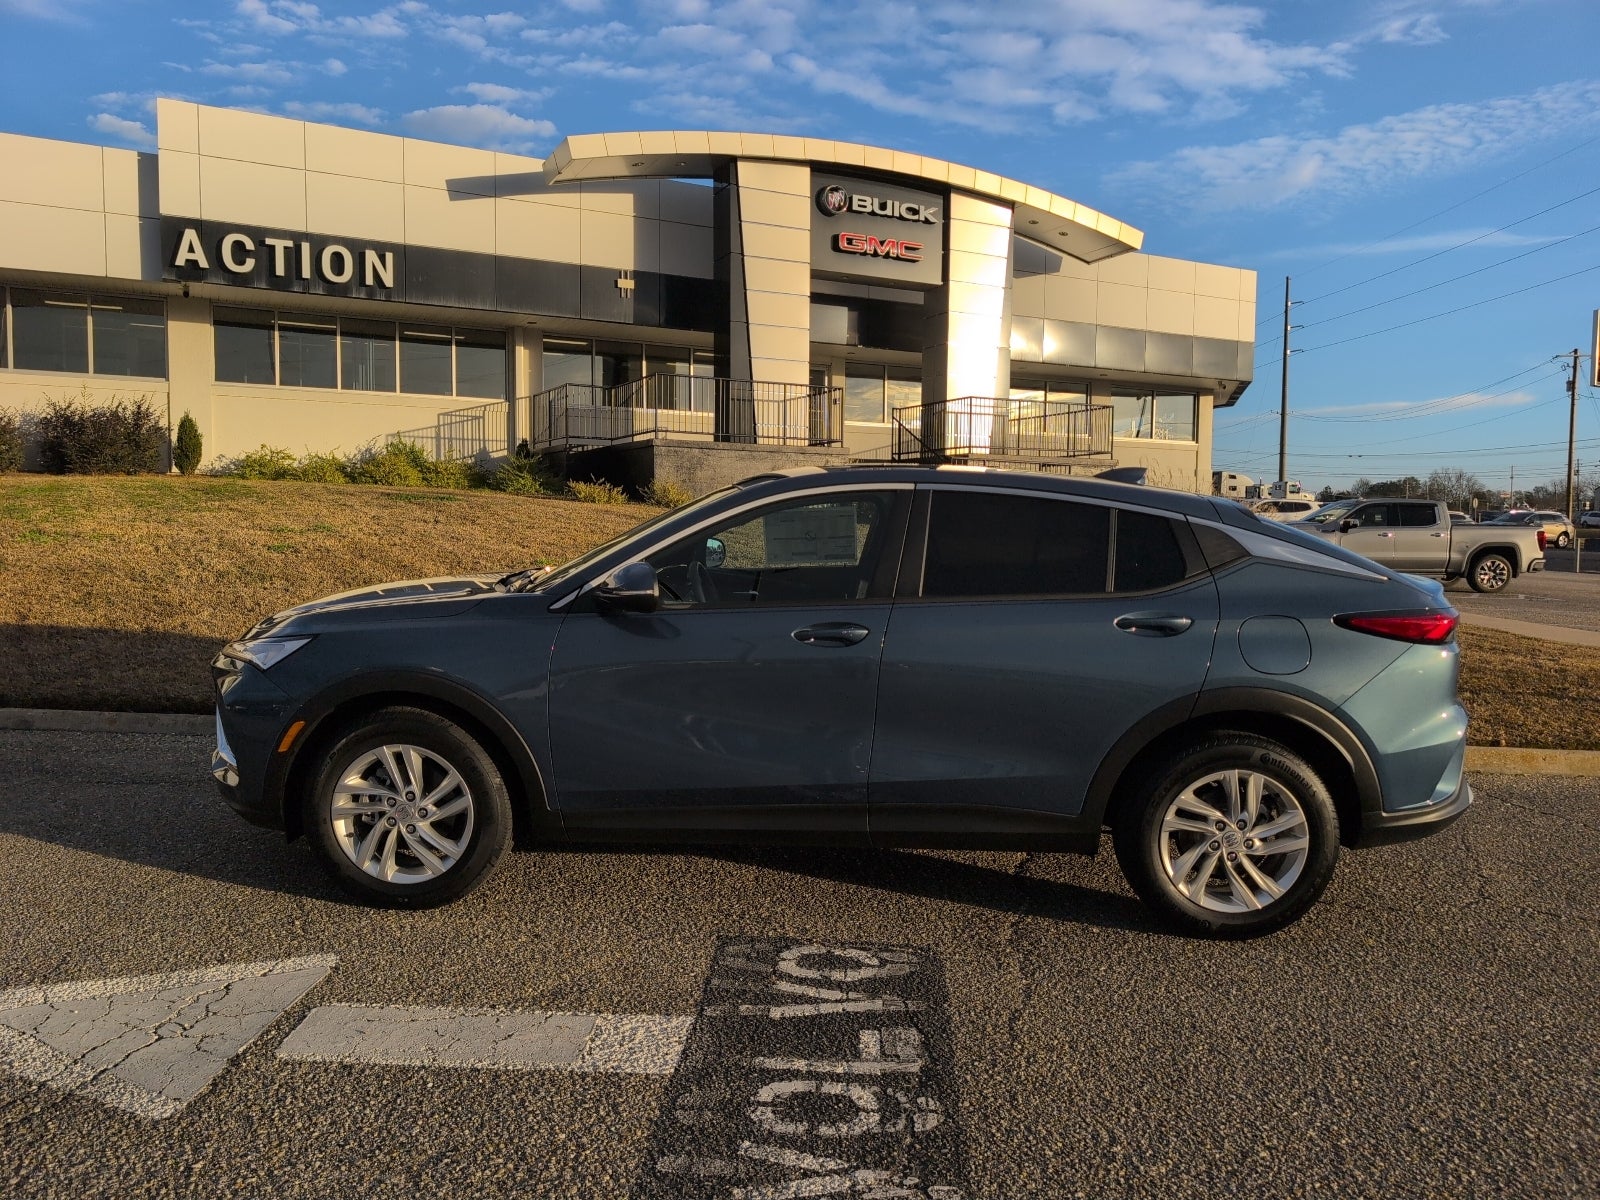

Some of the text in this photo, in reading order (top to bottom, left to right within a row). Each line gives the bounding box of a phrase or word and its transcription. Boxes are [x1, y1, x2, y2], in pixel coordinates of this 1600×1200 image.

[851, 194, 940, 223] BUICK
[173, 228, 394, 288] ACTION
[838, 231, 924, 261] GMC
